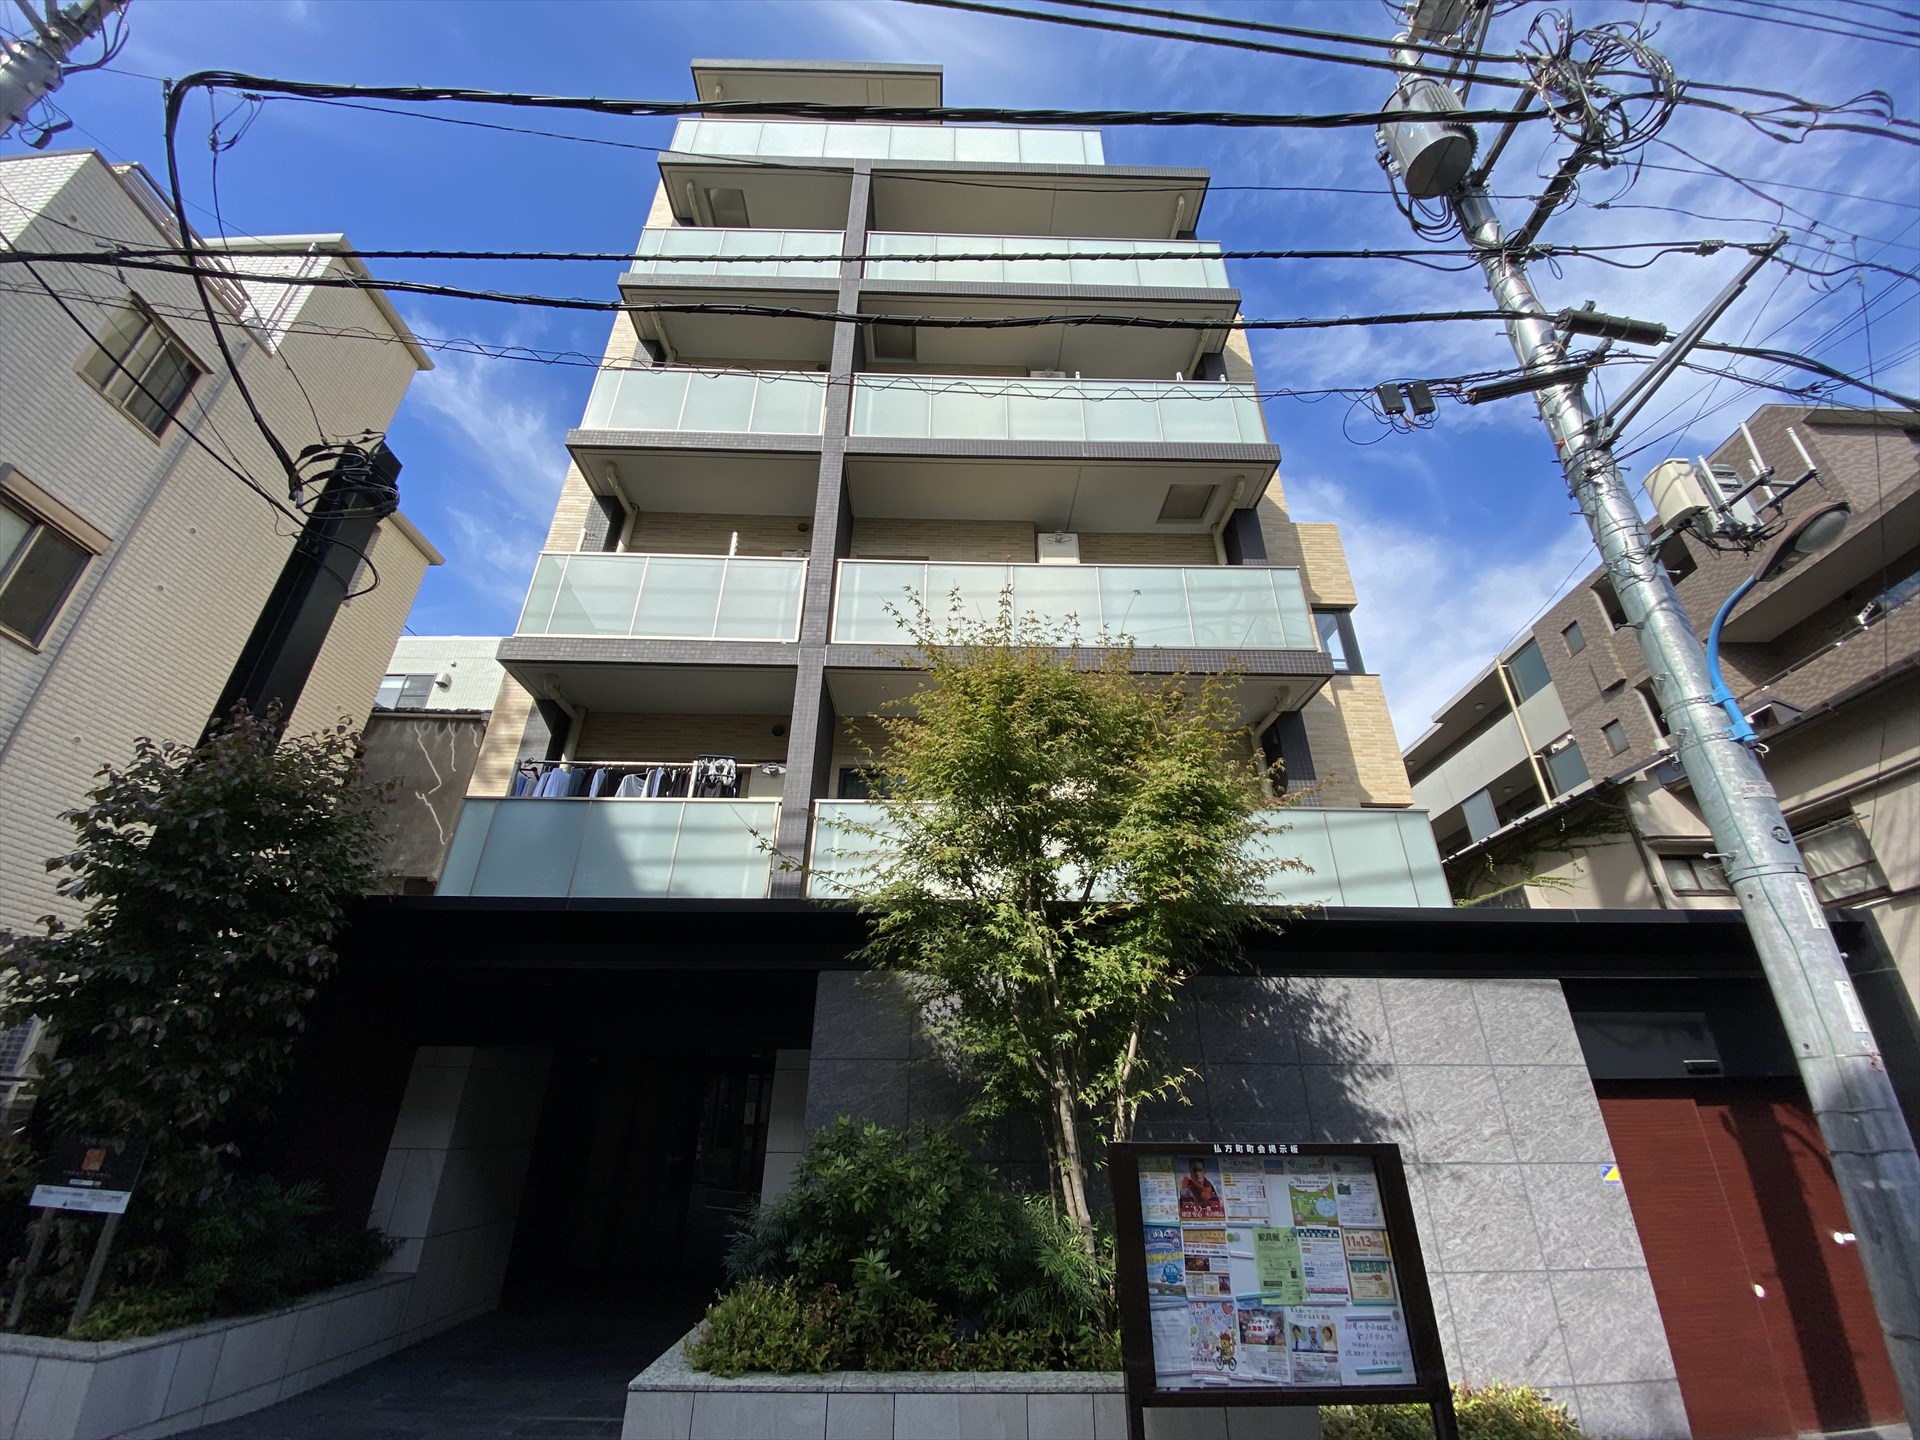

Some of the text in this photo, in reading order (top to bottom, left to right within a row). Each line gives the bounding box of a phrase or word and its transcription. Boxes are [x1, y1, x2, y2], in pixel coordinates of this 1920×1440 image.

[1213, 1143, 1299, 1154] 払方町町会掲示板
